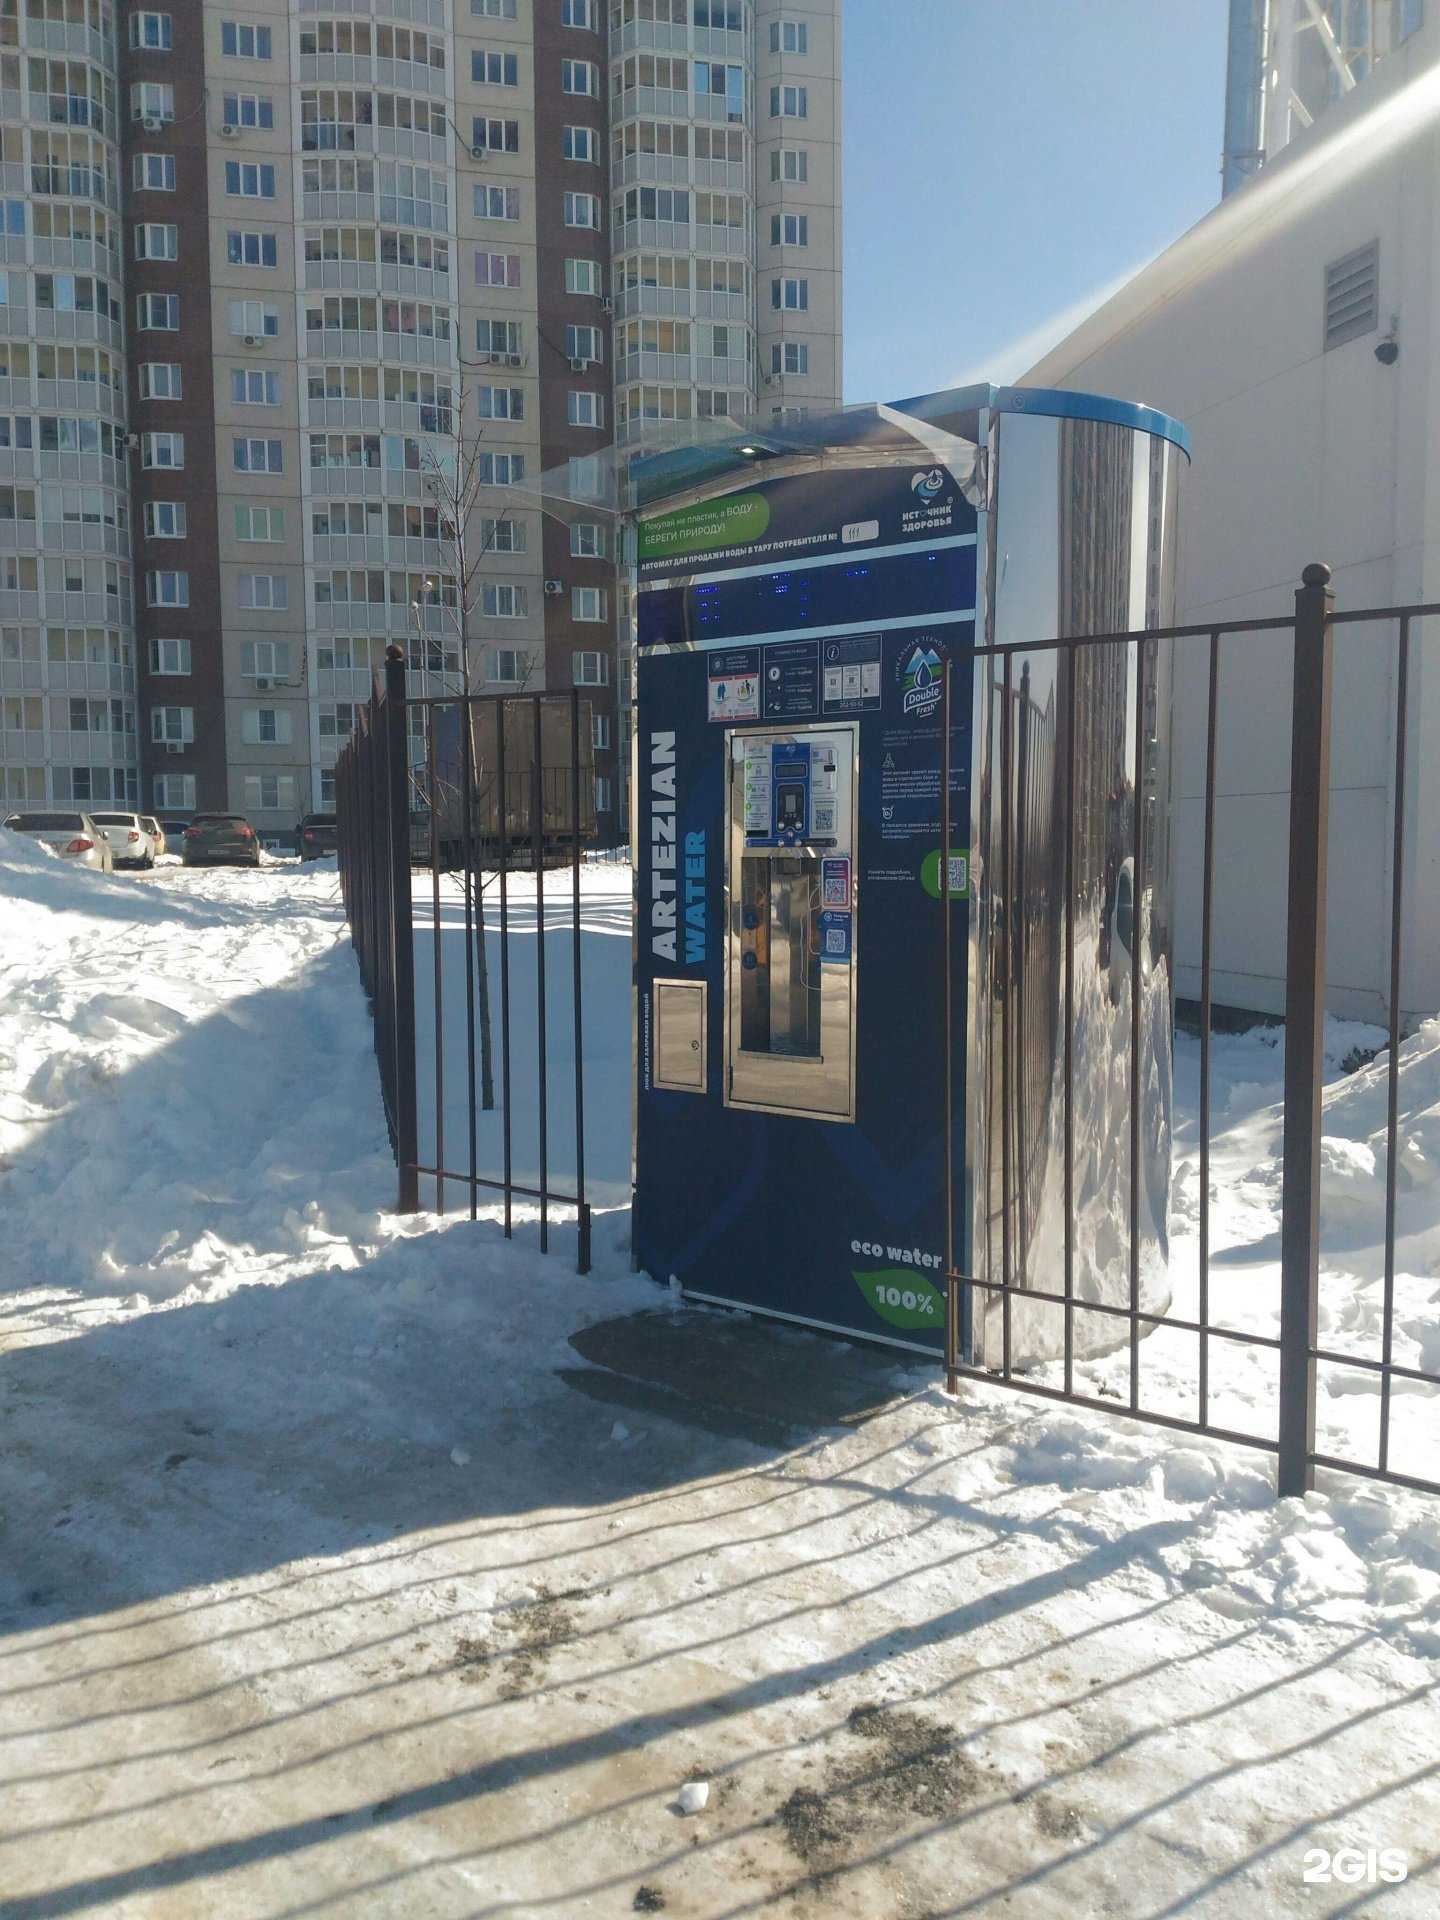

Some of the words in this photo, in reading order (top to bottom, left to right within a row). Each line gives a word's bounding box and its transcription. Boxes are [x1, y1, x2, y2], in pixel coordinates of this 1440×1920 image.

[645, 518, 675, 531] Покупай
[726, 503, 753, 516] ВОДУ
[902, 516, 952, 532] ЗДОРОВЬЯ
[645, 530, 678, 545] БЕРЕГИ
[679, 522, 726, 539] ПРИРОДУ!
[641, 559, 673, 570] АВТОМАТ
[673, 556, 688, 567] ДЛЯ
[688, 551, 725, 564] ПРОДАЖИ
[725, 547, 747, 559] ВОДЫ
[747, 545, 753, 554] В
[753, 542, 773, 554] ТАРУ
[773, 534, 827, 550] ПОТРЕБИТЕЛЯ
[908, 687, 940, 704] Double
[916, 703, 935, 715] Fresh
[651, 731, 677, 962] ARTEZIAN
[684, 829, 706, 965] WATER
[850, 1239, 884, 1257] eco
[886, 1246, 943, 1269] water
[875, 1285, 934, 1315] 100%
